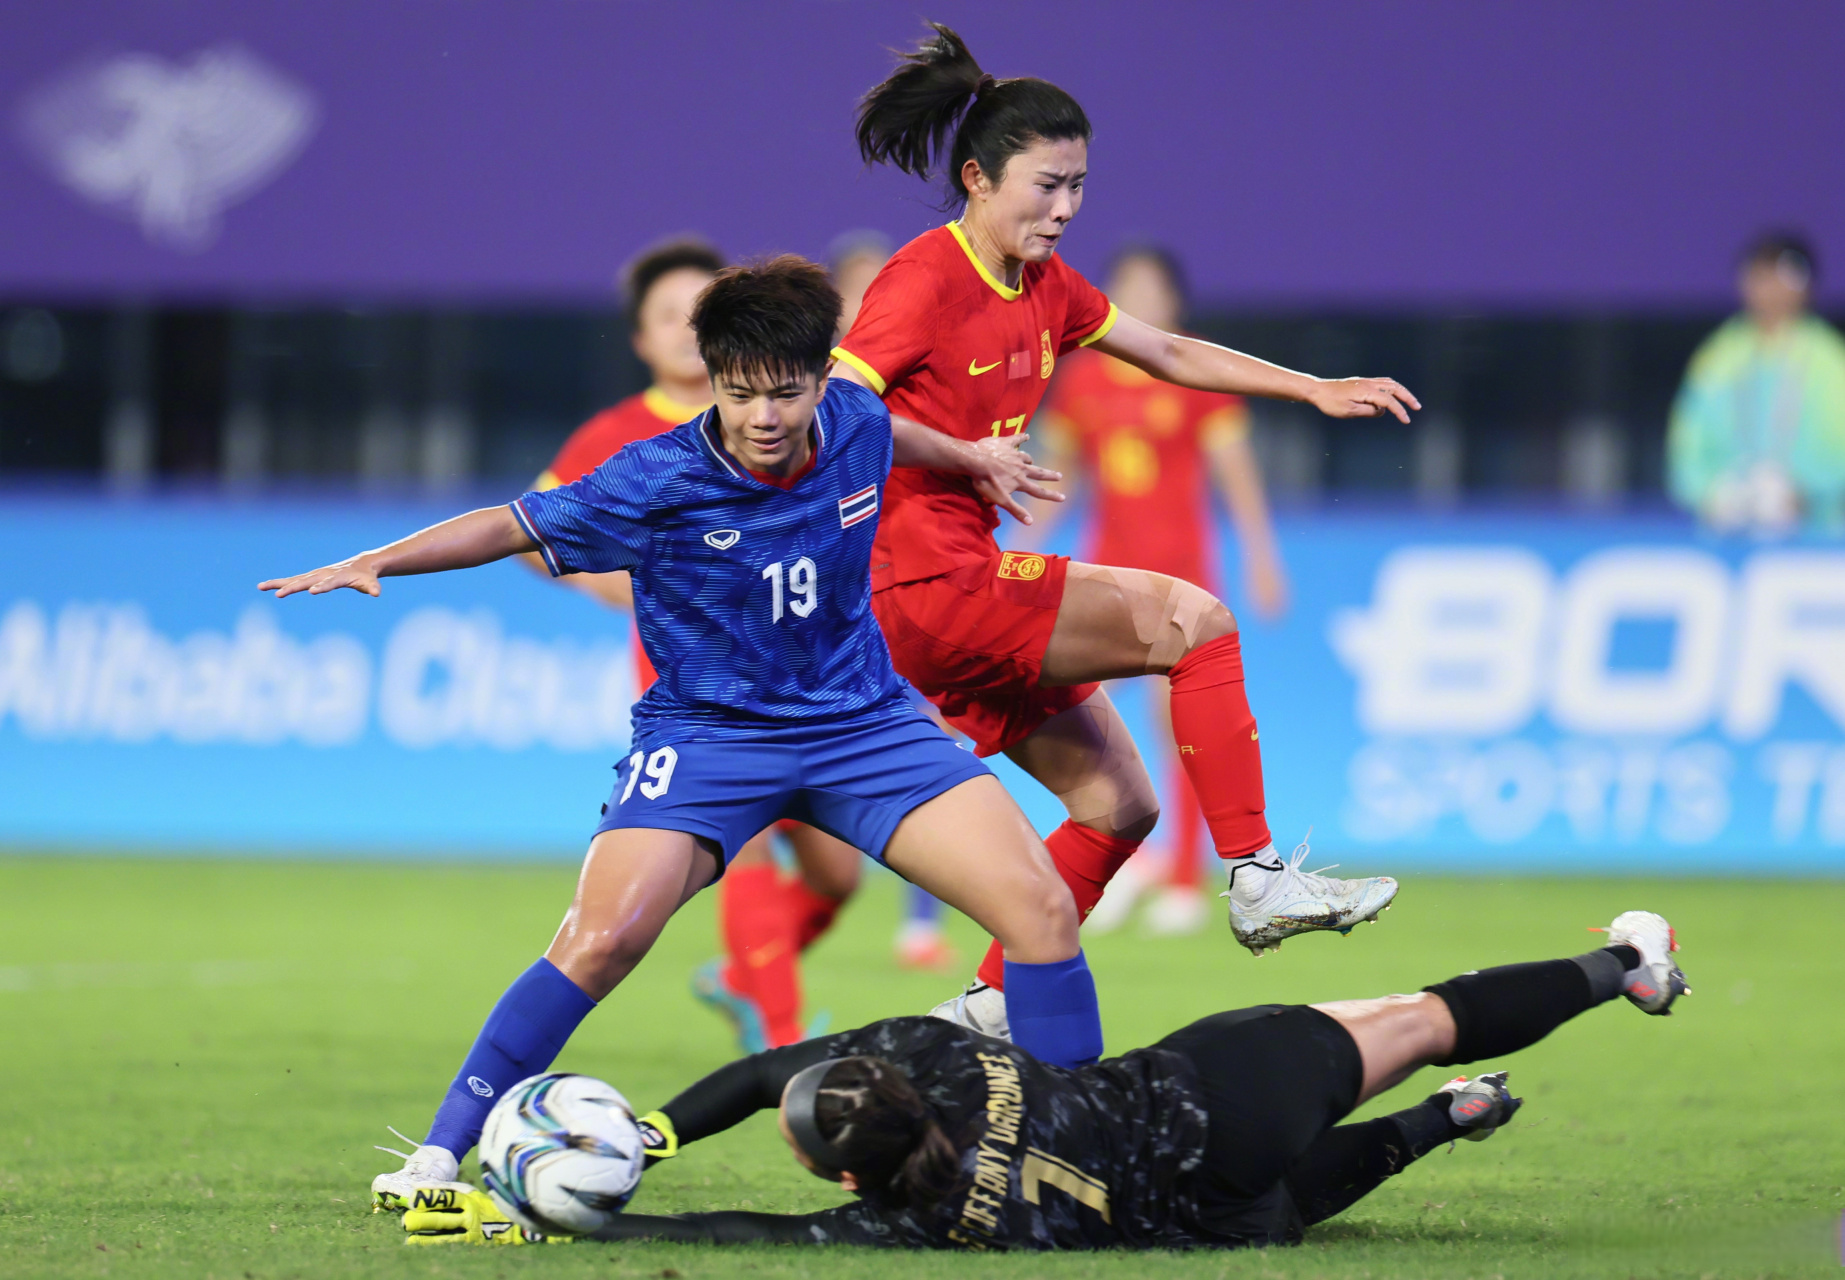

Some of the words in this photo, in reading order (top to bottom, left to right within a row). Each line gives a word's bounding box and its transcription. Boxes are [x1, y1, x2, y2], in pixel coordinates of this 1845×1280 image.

[762, 556, 818, 624] 19
[0, 604, 368, 742] Alibaba
[382, 608, 633, 748] Clou
[620, 745, 678, 805] 19
[1345, 742, 1736, 843] SPORTS
